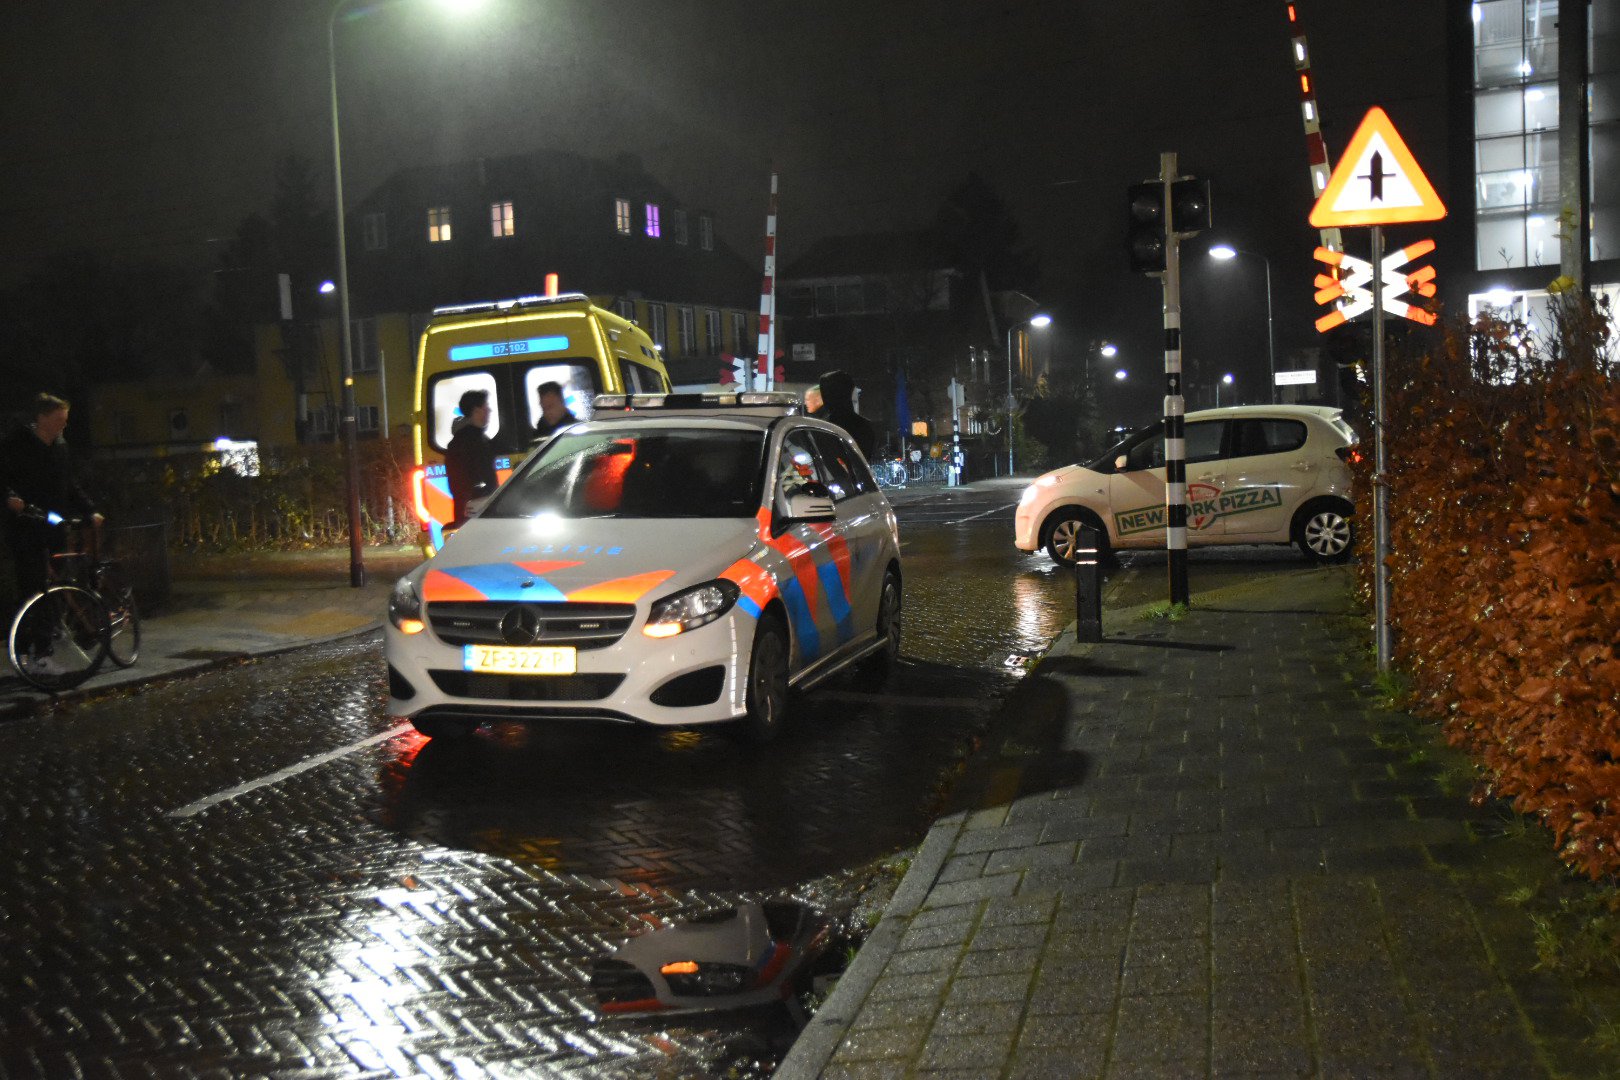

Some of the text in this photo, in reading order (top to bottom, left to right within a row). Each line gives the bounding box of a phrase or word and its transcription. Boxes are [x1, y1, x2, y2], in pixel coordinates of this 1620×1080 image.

[494, 342, 526, 355] 07-102
[1121, 508, 1165, 530] NEW
[1184, 498, 1218, 518] ORK
[1219, 488, 1275, 511] PIZZA
[499, 543, 624, 556] POLITIE
